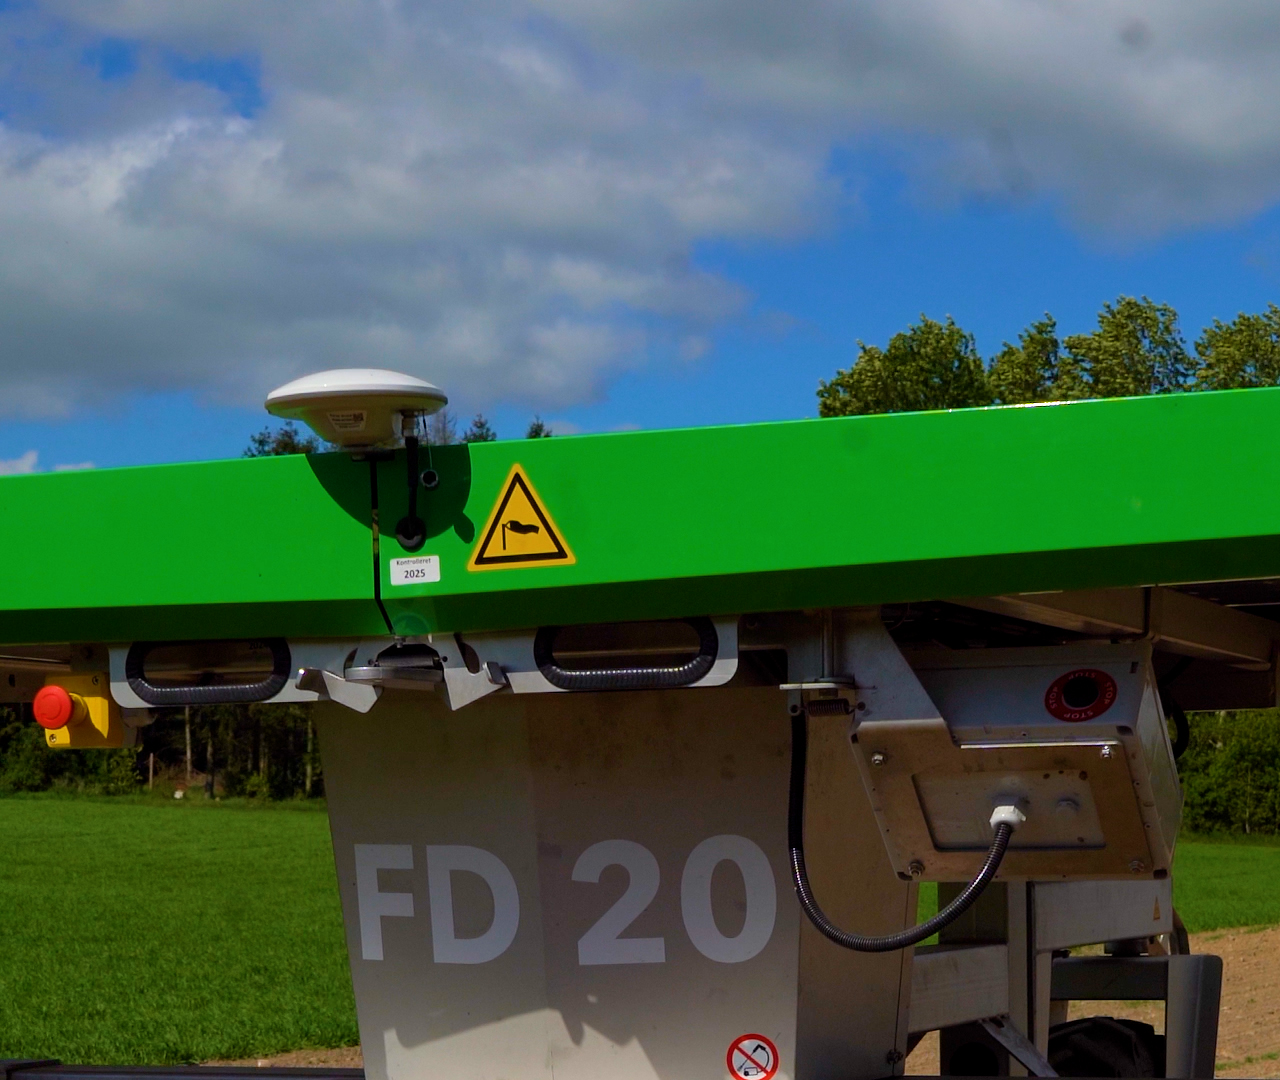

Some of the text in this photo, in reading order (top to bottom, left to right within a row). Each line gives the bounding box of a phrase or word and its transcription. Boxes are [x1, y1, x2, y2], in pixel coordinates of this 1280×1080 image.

[396, 557, 431, 566] Kontrolleret
[404, 568, 426, 579] 2025
[1049, 686, 1058, 708] STOP
[1103, 681, 1113, 704] STOP
[1063, 710, 1093, 719] STOP
[354, 834, 778, 966] FD 20
